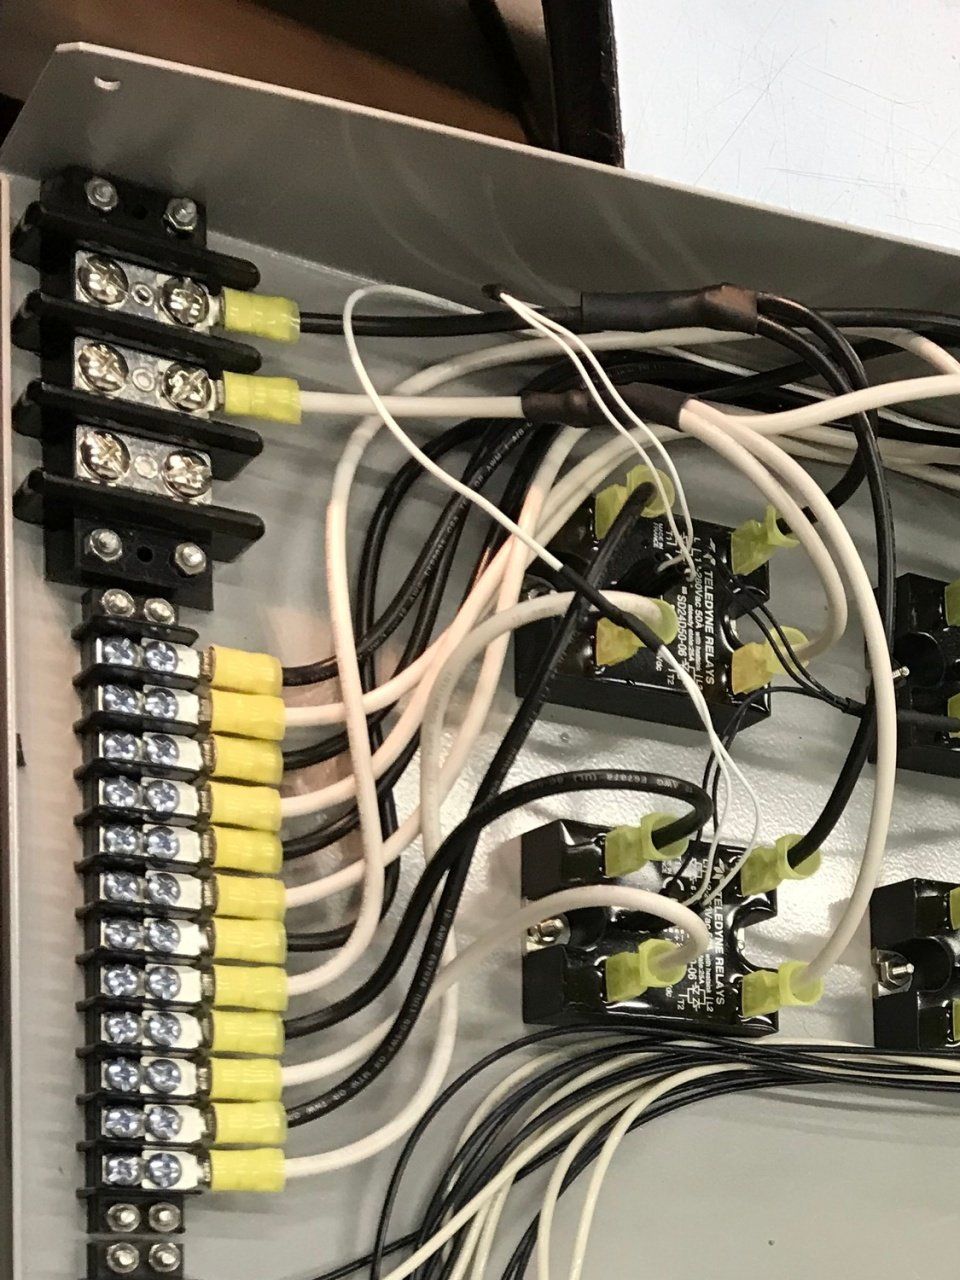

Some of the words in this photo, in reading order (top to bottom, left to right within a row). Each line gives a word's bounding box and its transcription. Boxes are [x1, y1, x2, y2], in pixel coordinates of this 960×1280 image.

[676, 594, 687, 657] SD24D50-06
[695, 610, 703, 629] 50A
[703, 570, 715, 634] TELEDYNE
[705, 636, 715, 685] RELAYS
[713, 891, 724, 954] TELEDYNE
[676, 999, 685, 1010] T2
[715, 957, 725, 1005] RELAYS
[706, 1001, 714, 1012] L2
